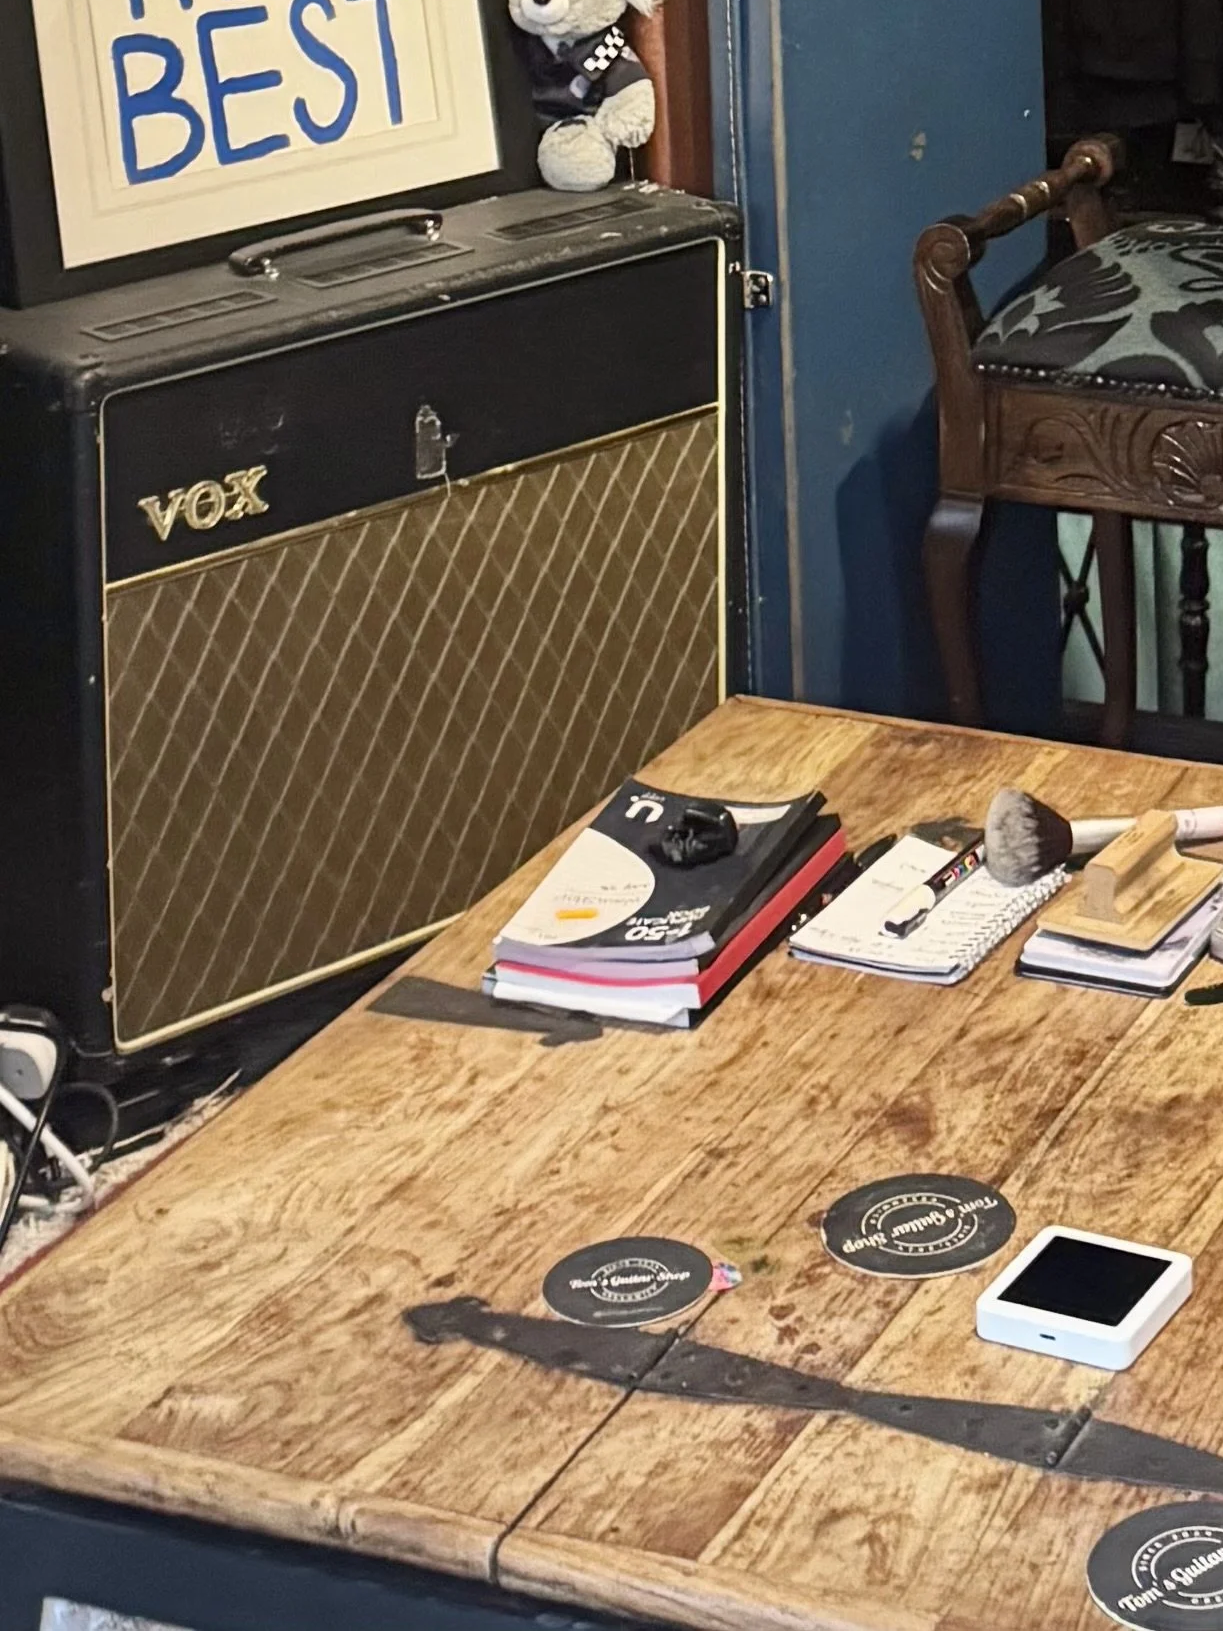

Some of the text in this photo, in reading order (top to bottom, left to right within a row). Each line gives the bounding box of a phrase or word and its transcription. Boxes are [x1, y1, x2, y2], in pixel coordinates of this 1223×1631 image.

[137, 465, 270, 541] VOX
[948, 1196, 998, 1219] Tom's
[891, 1210, 947, 1237] Guitar
[842, 1231, 888, 1254] Shop
[1118, 1578, 1176, 1612] Tom's
